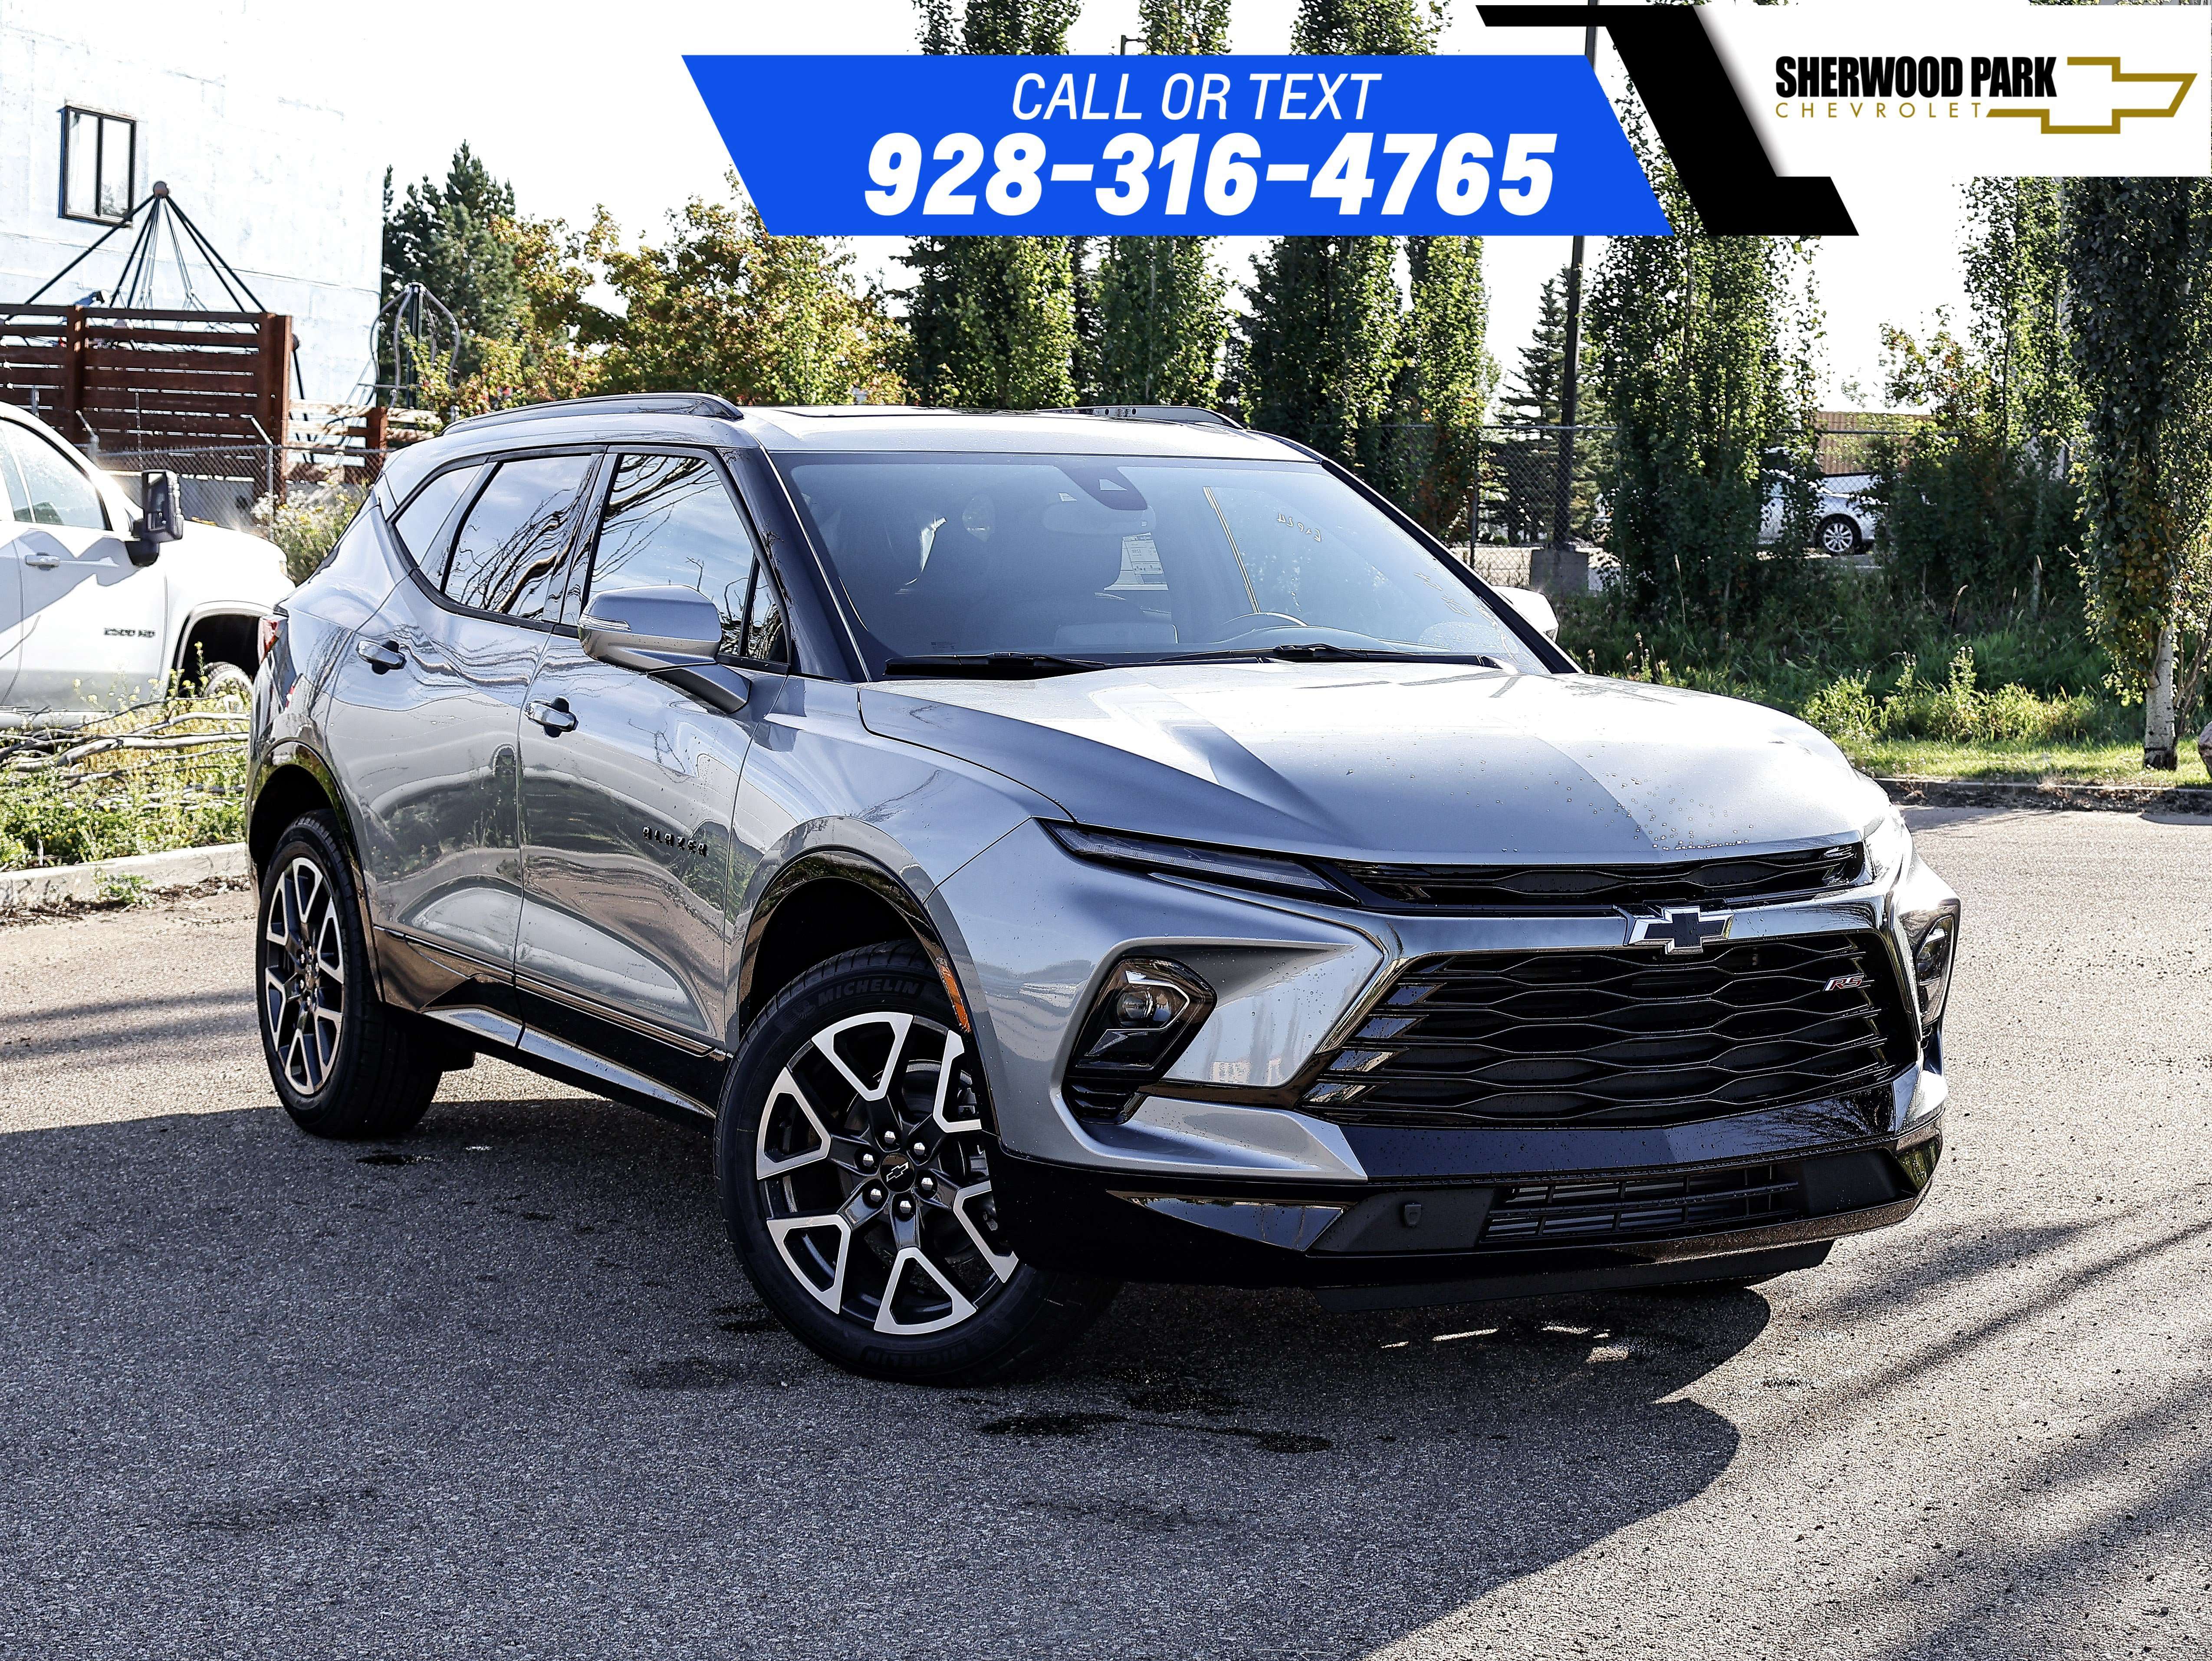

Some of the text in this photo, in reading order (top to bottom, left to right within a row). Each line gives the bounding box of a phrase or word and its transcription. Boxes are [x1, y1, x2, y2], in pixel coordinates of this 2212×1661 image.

[643, 826, 707, 858] BLAZER
[818, 979, 919, 1005] MICHELIN
[1826, 974, 1864, 991] RS
